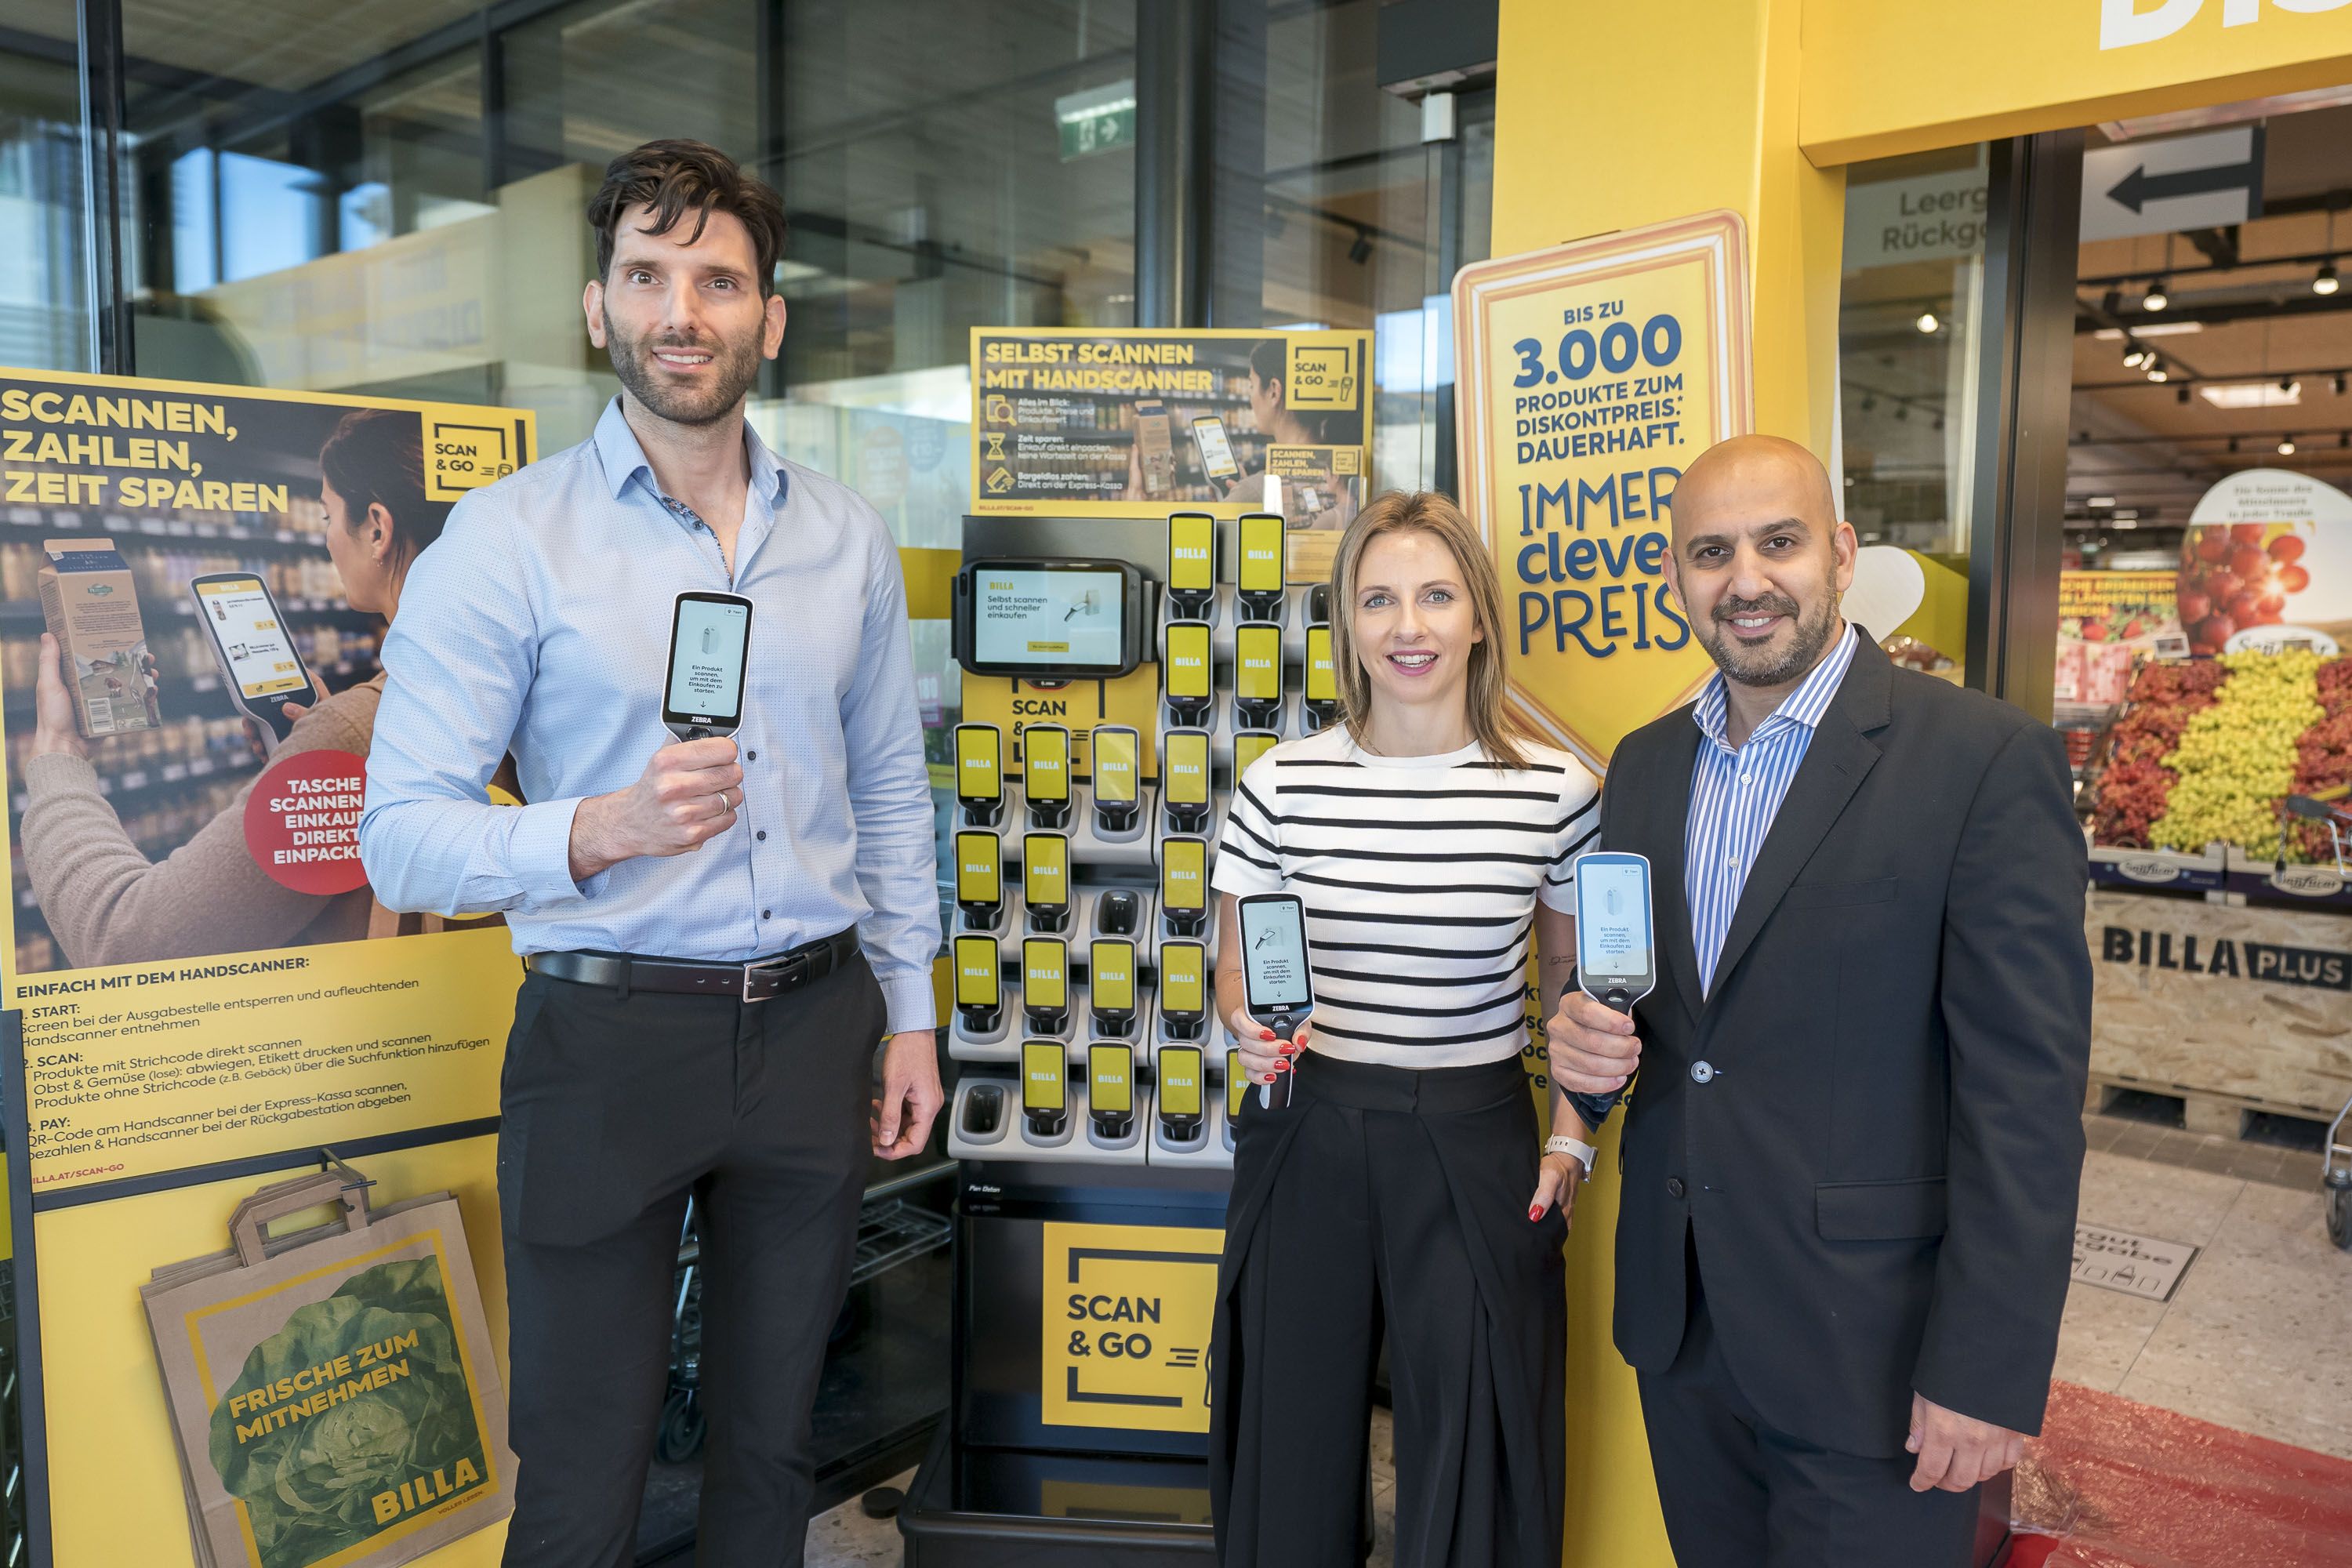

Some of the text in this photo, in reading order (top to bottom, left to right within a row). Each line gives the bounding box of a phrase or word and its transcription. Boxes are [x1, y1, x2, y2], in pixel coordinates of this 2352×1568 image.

[1900, 186, 1987, 216] Leerg
[1882, 220, 1986, 252] Rückg
[1564, 299, 1624, 325] BIS ZU
[985, 343, 1194, 365] SELBST SCANNEN
[1513, 314, 1682, 388] 3.000
[1295, 363, 1327, 372] SCAN
[986, 369, 1213, 390] MIT HANDSCANNER
[1295, 376, 1323, 385] & GO
[1515, 373, 1682, 414] PRODUKTE ZUM
[1, 390, 238, 441] SCANNEN,
[1018, 434, 1033, 443] Zeit
[1517, 421, 1684, 464] DAUERHAFT.
[3, 430, 203, 477] ZAHLEN,
[435, 443, 477, 456] SCAN
[437, 459, 474, 471] & GO
[5, 470, 289, 513] ZEIT SPAREN
[1519, 466, 1682, 536] IMMER
[1174, 547, 1207, 560] BILLA
[1248, 550, 1273, 560] BILLA
[1517, 532, 1668, 584] cleve
[1519, 582, 1690, 658] PREIS
[1175, 657, 1201, 666] BILLA
[1245, 659, 1271, 668] BILLA
[1012, 700, 1066, 717] SCAN
[966, 759, 991, 768] BILLA
[1034, 760, 1059, 770] BILLA
[1102, 762, 1128, 771] BILLA
[1174, 765, 1199, 775] BILLA
[287, 777, 361, 793] TASCHE
[270, 793, 363, 812] SCANNEN
[293, 828, 358, 845] DIREKT
[966, 864, 991, 873] BILLA
[1033, 866, 1058, 876] BILLA
[1171, 870, 1196, 880] BILLA
[2103, 925, 2344, 984] BILLA PLUS
[16, 957, 310, 998] EINFACH MIT DEM HANDSCANNER:
[964, 967, 989, 977] BILLA
[1029, 969, 1060, 980] BILLA
[1100, 972, 1126, 982] BILLA
[1170, 974, 1195, 983] BILLA
[21, 979, 419, 1033] Screen bei der Ausgabestelle entsperren und aufleuchtenden
[32, 1004, 80, 1018] START:
[23, 1018, 200, 1047] Handscanner entnehmen
[33, 1038, 302, 1081] Produkte mit Strichcode direkt scannen
[34, 1033, 431, 1095] Obst & Gemüse (lose): abwiegen, Etikett drucken und scannen
[38, 1052, 83, 1067] SCAN:
[34, 1037, 490, 1109] Produkte ohne Strichcode Gebäck) über die Suchfunktion hinzufügen
[1031, 1073, 1056, 1082] BILLA
[1098, 1075, 1123, 1083] BILLA
[1167, 1078, 1192, 1087] BILLA
[28, 1080, 408, 1147] QR-Code am Handscanner bei der Express-Kassa scannen,
[94, 1138, 104, 1149] &
[107, 1127, 198, 1148] Handscanner
[202, 1121, 222, 1133] bei
[225, 1118, 247, 1130] der
[250, 1101, 355, 1125] Rückgabestation
[358, 1092, 411, 1109] abgeben
[40, 1117, 71, 1131] PAY:
[33, 1163, 125, 1184] ILLA.AT/SCAN-GO
[1067, 1294, 1160, 1324] SCAN
[1068, 1330, 1152, 1359] & GO
[229, 1329, 419, 1418] FRISCHE ZUM
[235, 1358, 410, 1444] MITNEHMEN
[372, 1457, 480, 1525] BILLA
